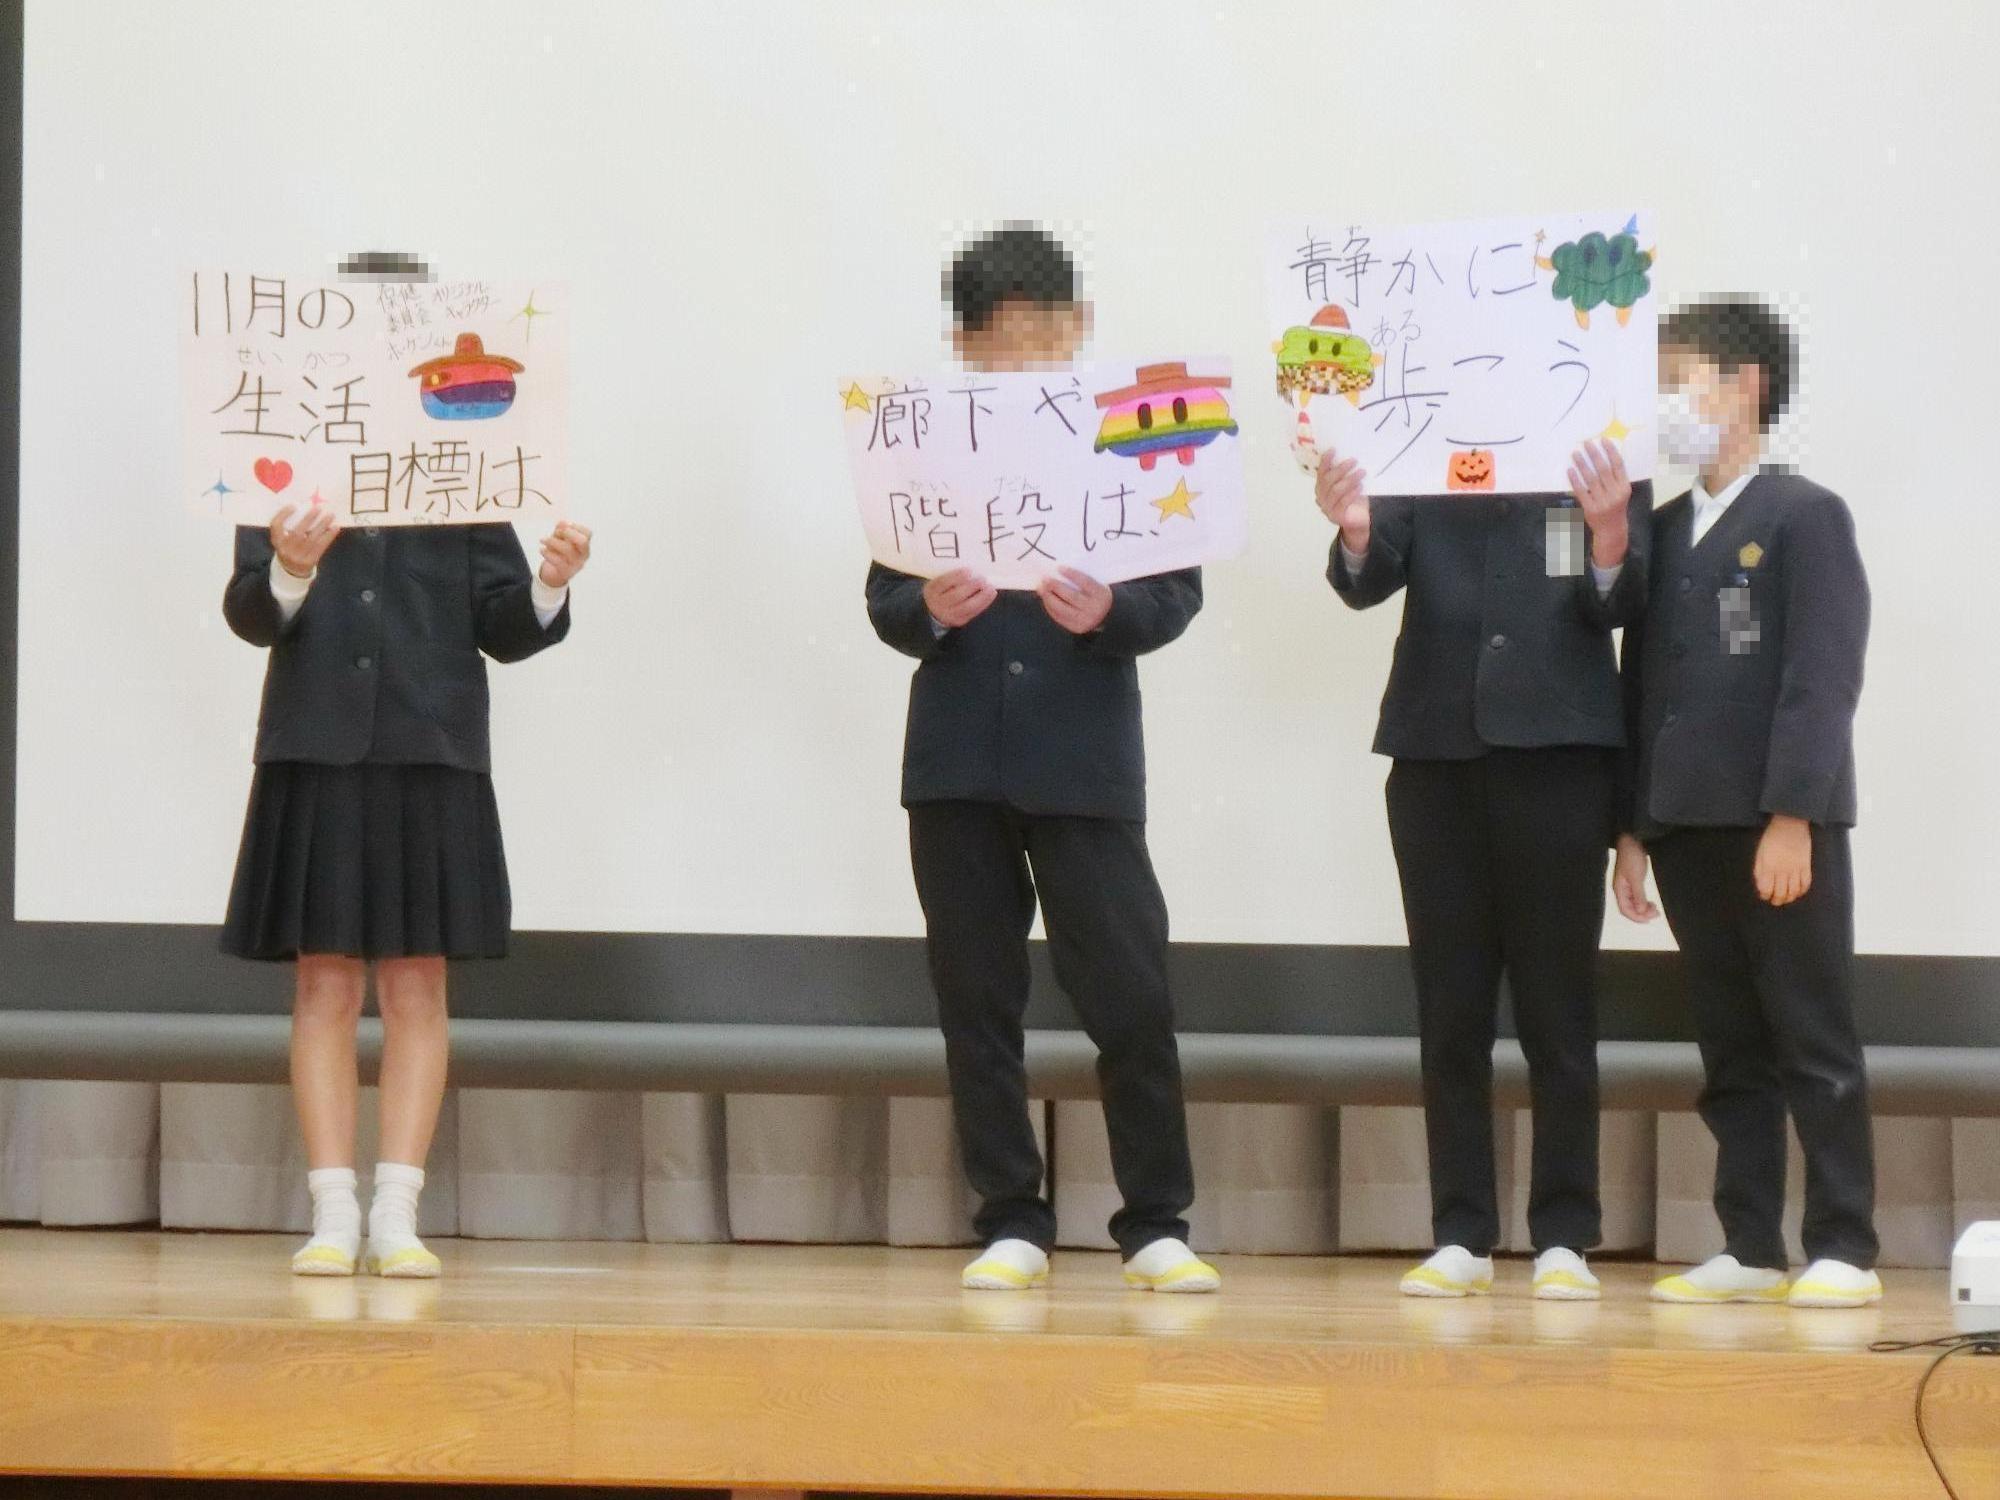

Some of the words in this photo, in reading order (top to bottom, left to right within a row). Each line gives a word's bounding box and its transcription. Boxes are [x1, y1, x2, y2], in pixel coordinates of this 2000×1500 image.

[193, 271, 355, 338] 11月の
[1289, 235, 1537, 308] 静かに
[211, 369, 371, 447] 生活
[867, 376, 1083, 453] 廊下や
[1358, 339, 1591, 477] 歩こう
[348, 440, 552, 518] 目標は
